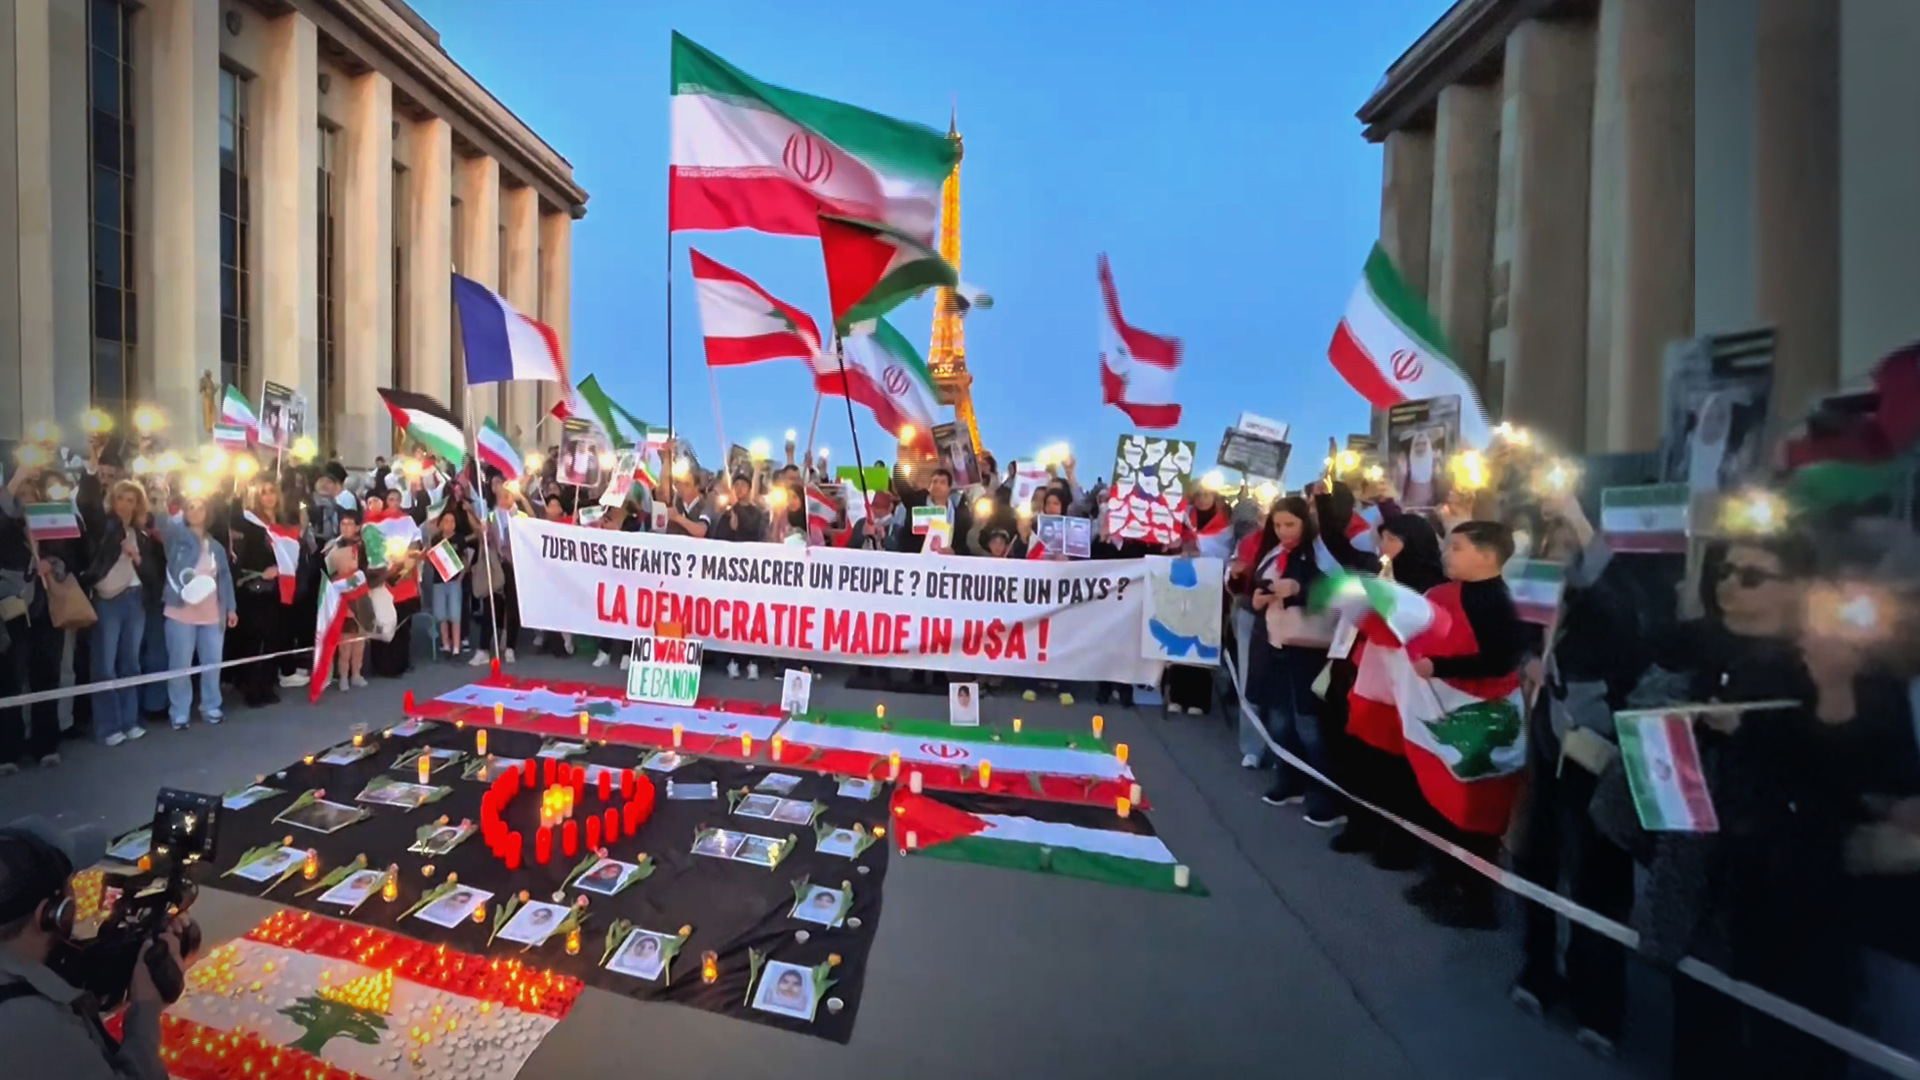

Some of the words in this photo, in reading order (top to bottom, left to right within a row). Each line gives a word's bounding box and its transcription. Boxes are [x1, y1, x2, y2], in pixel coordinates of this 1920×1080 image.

[541, 535, 578, 562] TUER
[580, 541, 607, 567] DES
[612, 545, 681, 577] ENFANTS
[686, 553, 697, 579] ?
[701, 555, 804, 588] MASSACRER
[809, 562, 833, 590] UN
[838, 564, 904, 596] PEUPLE
[909, 570, 921, 597] ?
[925, 565, 1018, 604] DÉTRUIRE
[1023, 578, 1051, 605] UN
[1057, 577, 1112, 605] PAYS
[1116, 576, 1130, 601] ?
[597, 581, 629, 626] LA
[636, 580, 816, 651] DÉMOCRATIE
[822, 607, 912, 656] MADE
[919, 616, 951, 655] IN
[961, 618, 1027, 661] U$A
[1037, 617, 1050, 662] !
[632, 637, 651, 663] NO
[654, 638, 686, 665] WAR
[686, 641, 703, 667] ON
[628, 666, 698, 701] LEBANON
